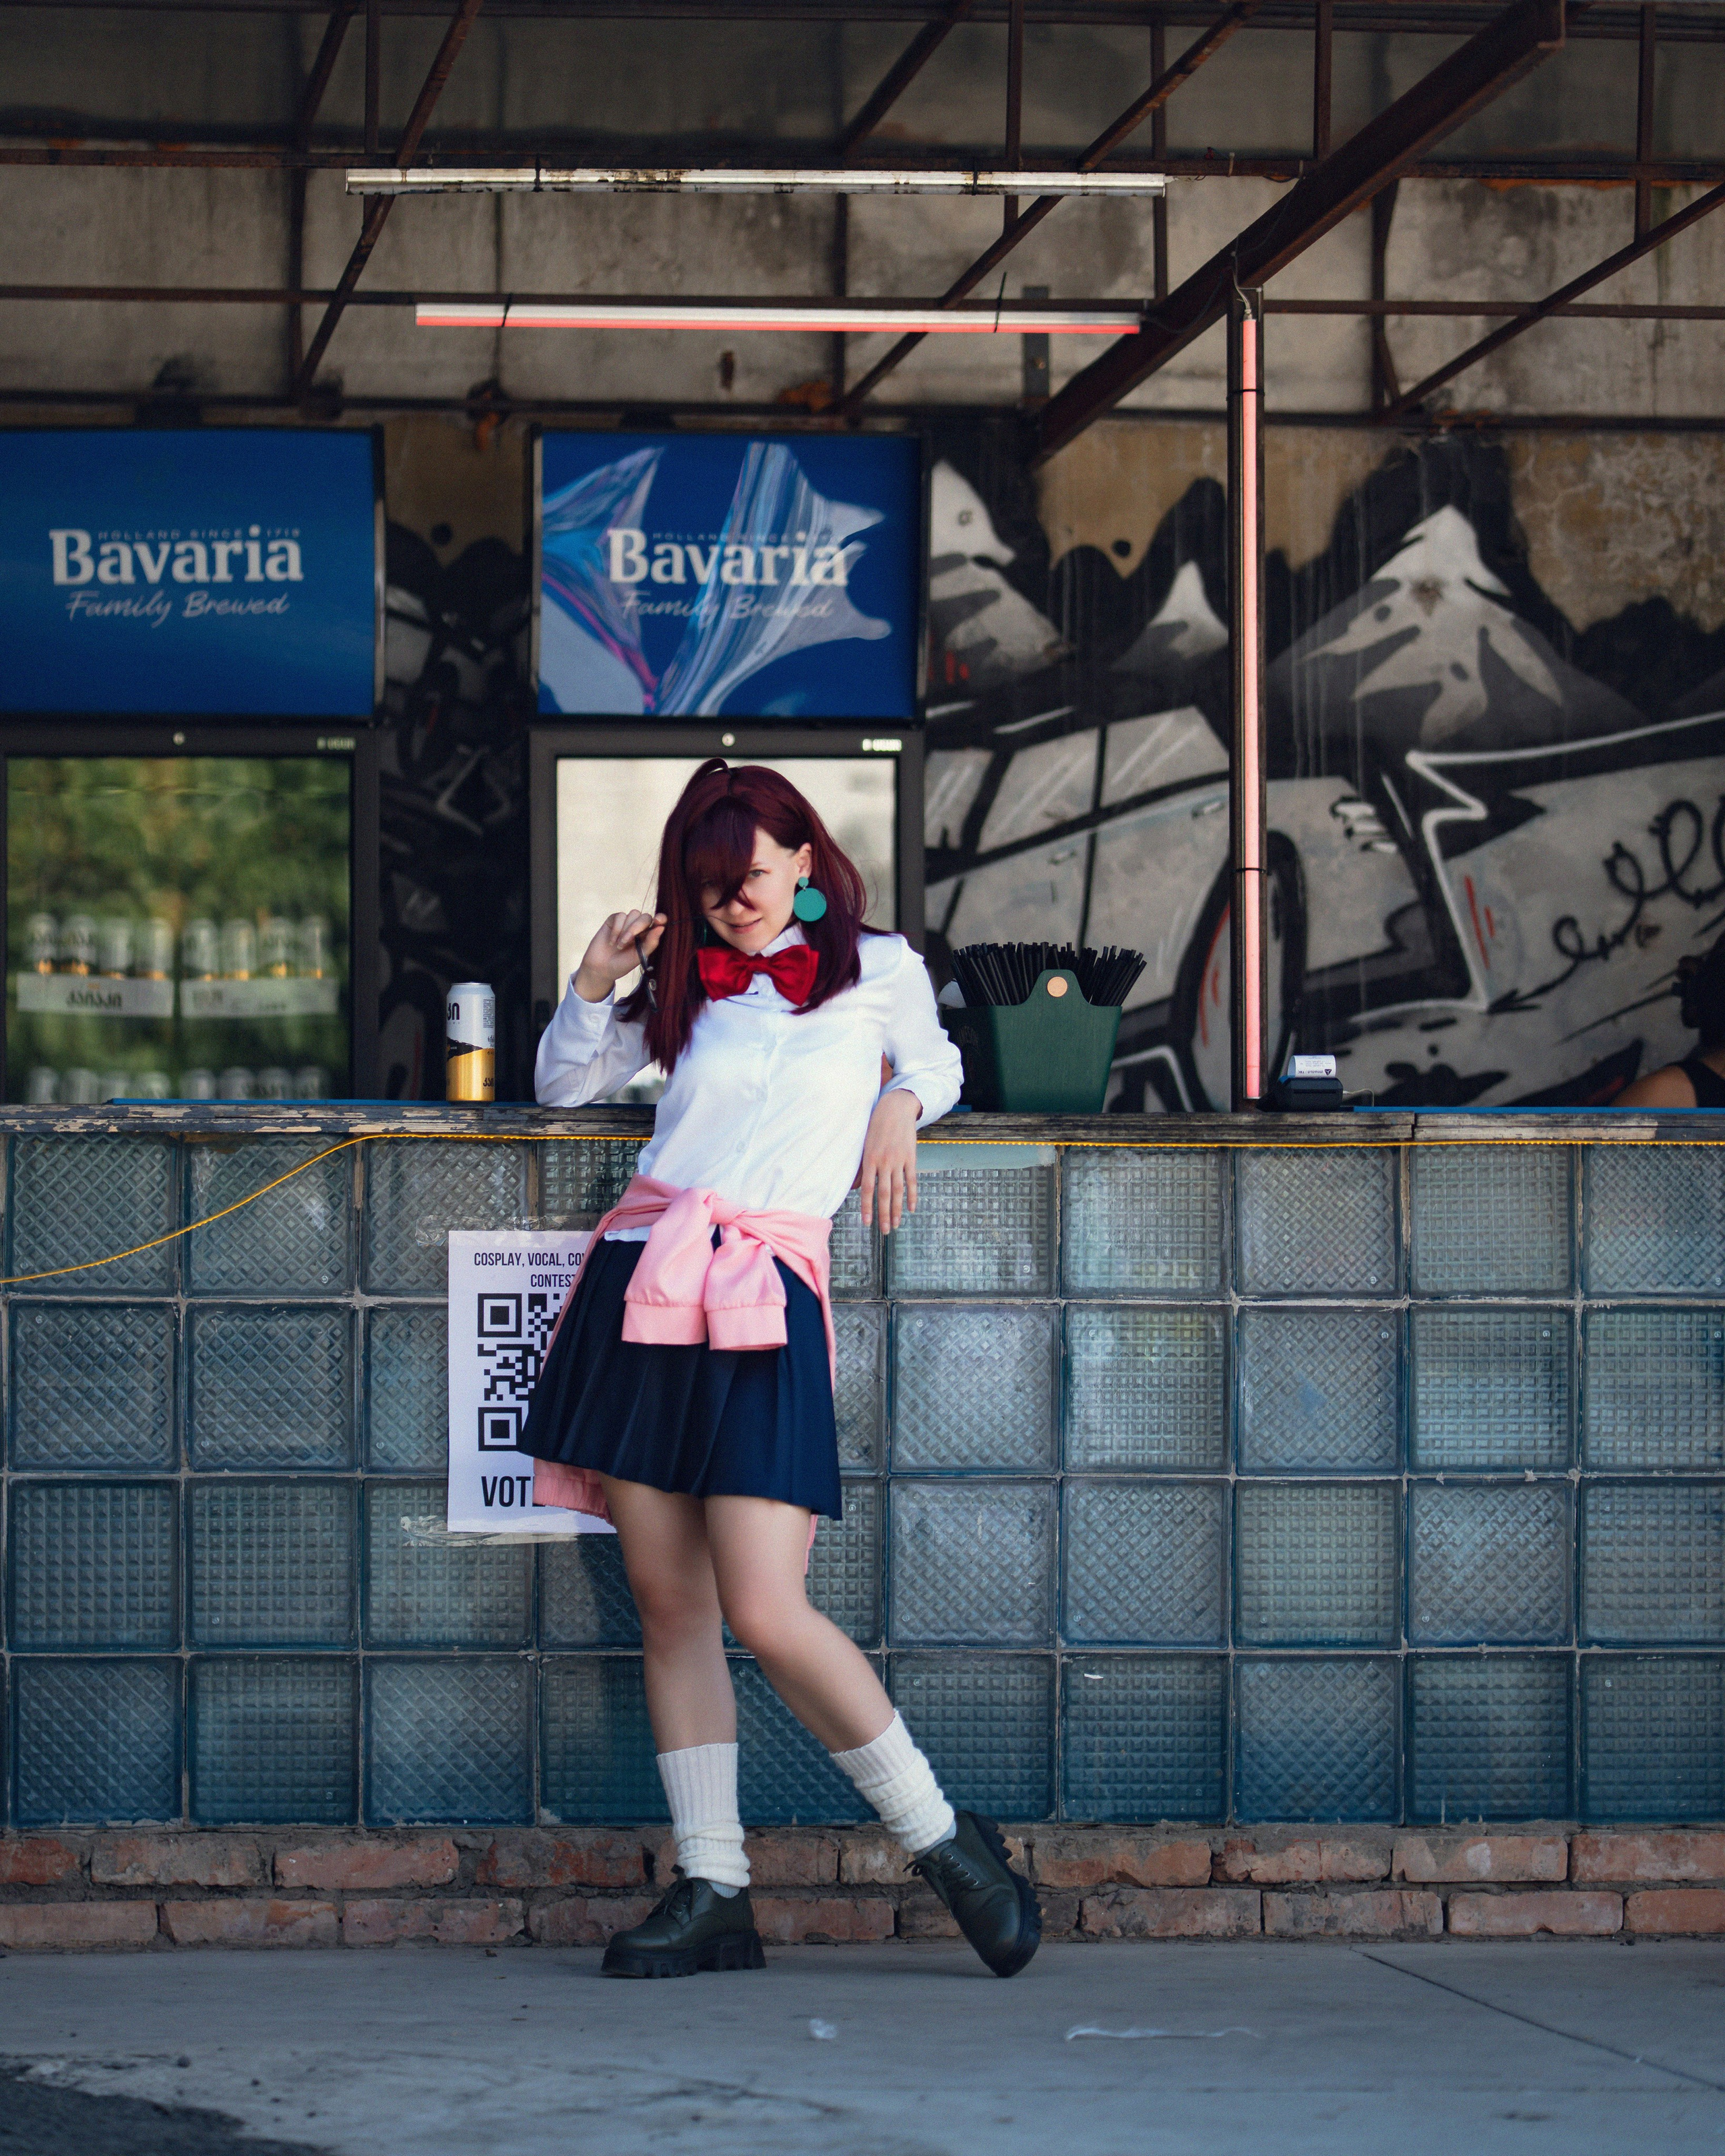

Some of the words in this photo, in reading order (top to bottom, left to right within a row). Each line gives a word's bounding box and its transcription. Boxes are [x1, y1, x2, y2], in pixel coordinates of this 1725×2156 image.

[98, 529, 181, 540] HOLLAND
[190, 528, 242, 539] SINCE
[49, 525, 304, 585] Bavaria
[608, 528, 848, 587] Bavaria
[65, 590, 172, 629] Family
[182, 590, 290, 619] Brewed
[621, 590, 720, 629] Family
[474, 1252, 525, 1267] COSPLAY,
[528, 1252, 565, 1267] VOCAL,
[567, 1252, 585, 1266] CO
